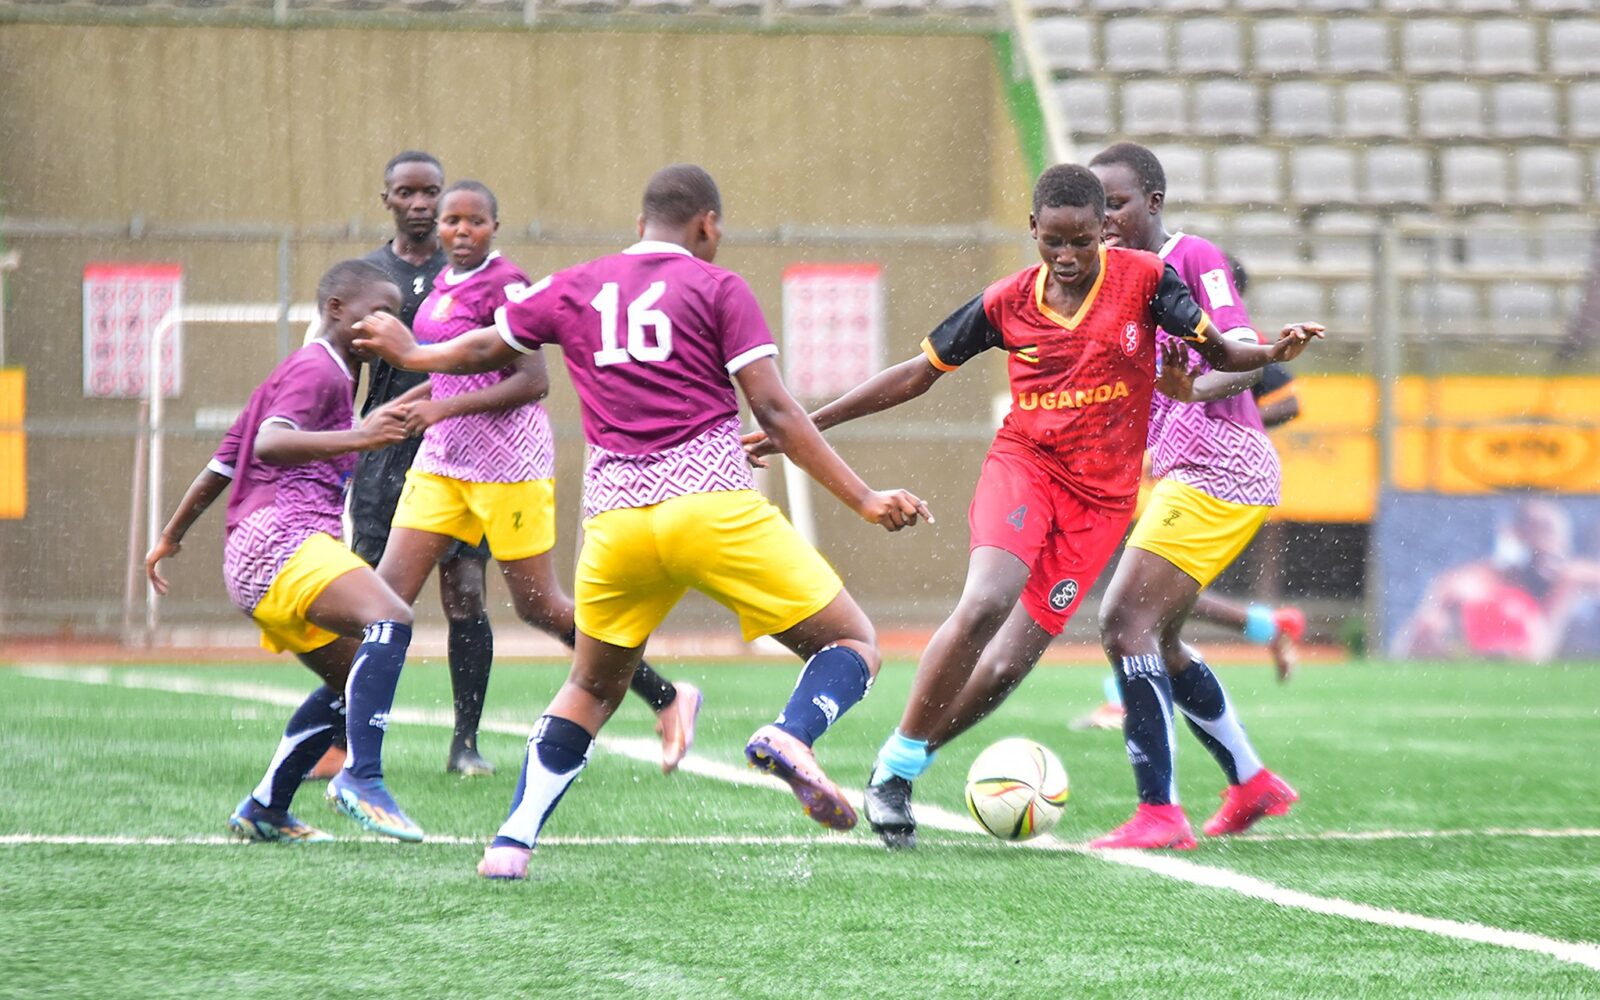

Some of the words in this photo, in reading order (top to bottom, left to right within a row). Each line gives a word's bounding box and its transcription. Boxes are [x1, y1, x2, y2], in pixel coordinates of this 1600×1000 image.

[590, 281, 673, 367] 16
[1018, 381, 1129, 411] UGANDA
[1008, 504, 1028, 530] 4
